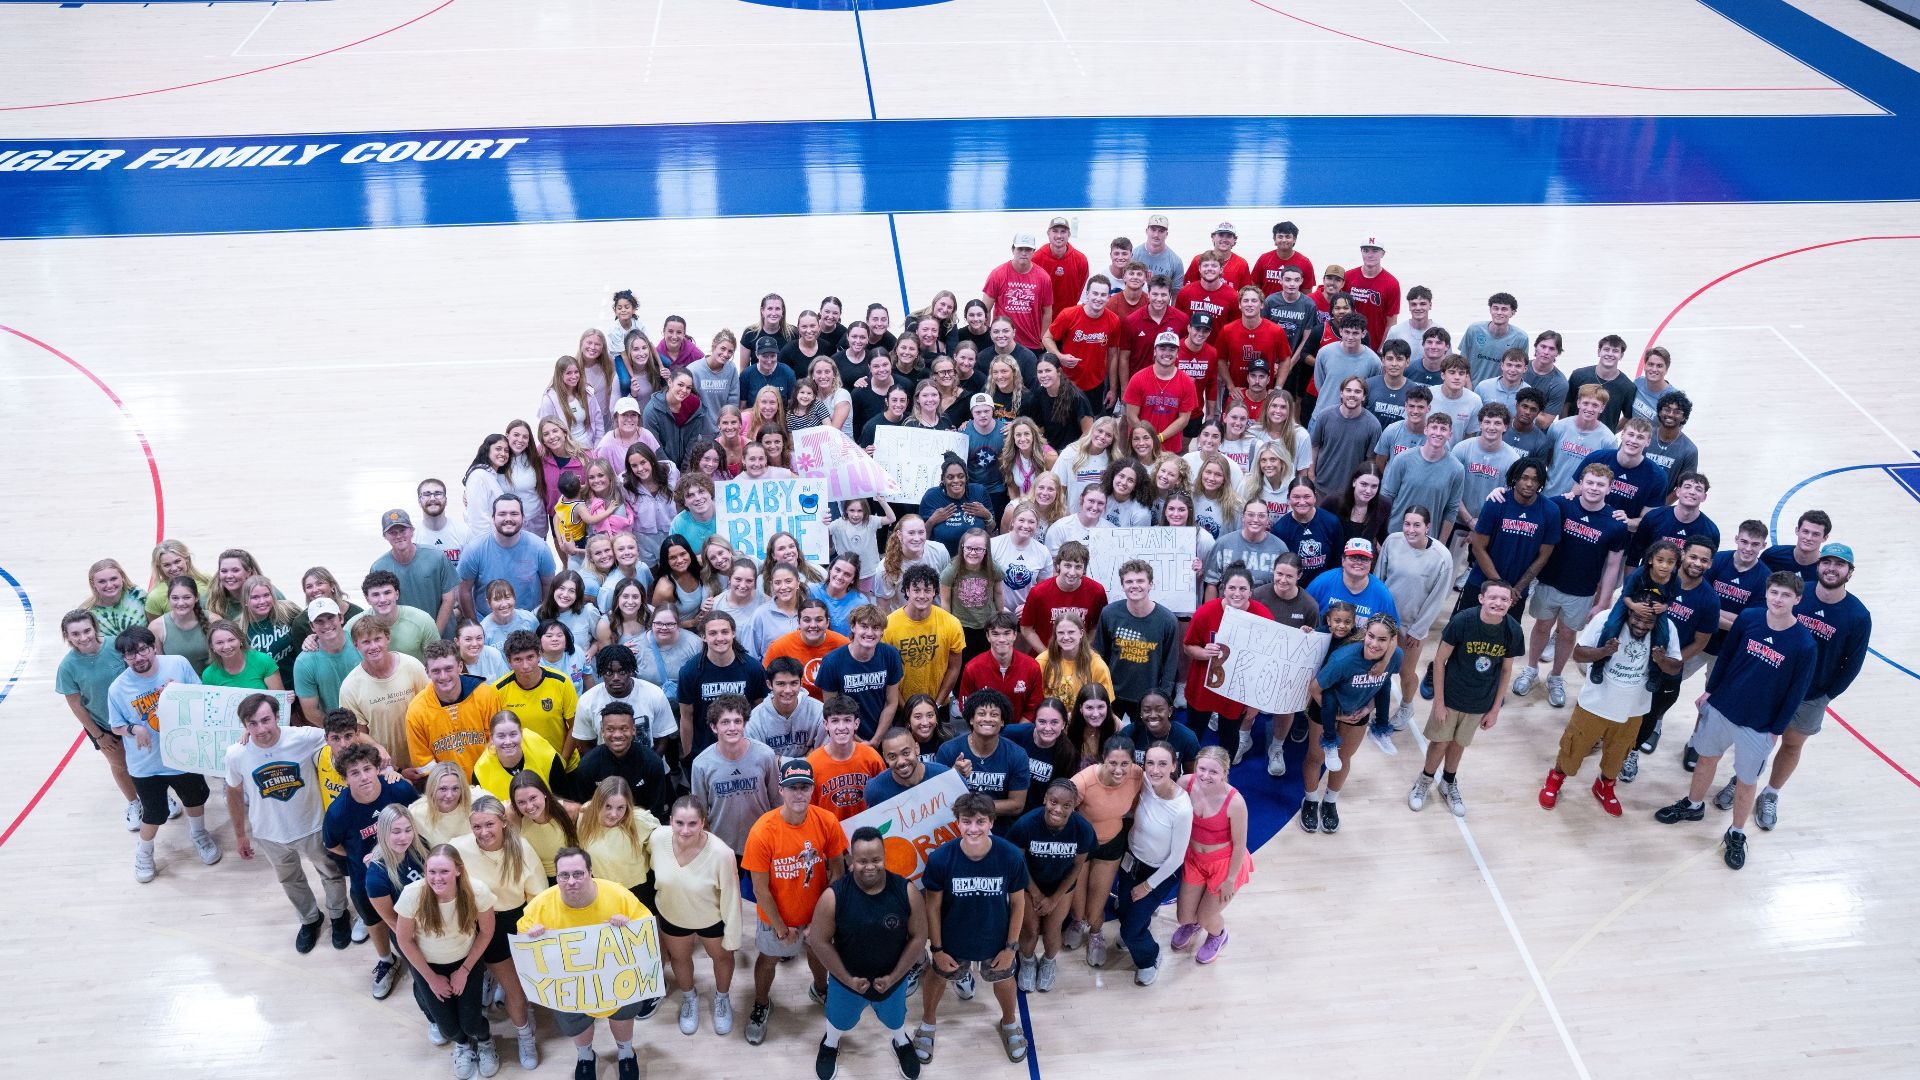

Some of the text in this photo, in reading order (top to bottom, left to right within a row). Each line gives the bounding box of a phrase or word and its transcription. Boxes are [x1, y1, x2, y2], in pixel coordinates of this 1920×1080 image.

[123, 144, 342, 170] FAMILY
[339, 137, 529, 164] COURT
[1190, 301, 1224, 315] BELMONT
[1271, 308, 1305, 320] SEAHAWKS
[1178, 363, 1209, 371] BRUINS
[1181, 369, 1207, 377] ASEBALL
[1375, 402, 1406, 417] BELMONT
[1469, 463, 1499, 478] BELMONT
[725, 480, 796, 514] BABY
[1502, 518, 1538, 535] BELMONT
[1564, 518, 1603, 542] BELMONT
[728, 514, 819, 562] BLUE
[1112, 529, 1177, 549] TEAM
[1713, 579, 1752, 601] BELMONT
[1796, 613, 1837, 639] BELMONT
[251, 624, 291, 652] Alpha
[1115, 638, 1158, 651] SATURDAY
[1225, 621, 1323, 664] TEAM
[1119, 653, 1149, 664] LIGHTS
[1121, 647, 1149, 656] NIGHT
[1746, 638, 1786, 666] BELMONT
[1613, 662, 1644, 671] Special
[843, 669, 887, 688] BELMONT
[1352, 671, 1388, 686] BELMONT
[702, 681, 747, 697] BELMONT
[369, 695, 386, 705] Lake
[433, 731, 486, 754] PREDATORS
[766, 730, 809, 749] BELMONT
[263, 775, 306, 789] TENNIS
[324, 778, 345, 793] LAK
[714, 776, 758, 794] BELMONT
[822, 773, 872, 795] AUBURN
[1030, 840, 1078, 856] BELMONT
[773, 856, 799, 866] RUN,
[774, 856, 822, 872] HUBBARD,
[952, 876, 1004, 893] BELMONT
[514, 919, 658, 975] TEAM
[520, 960, 661, 1012] YELLOW
